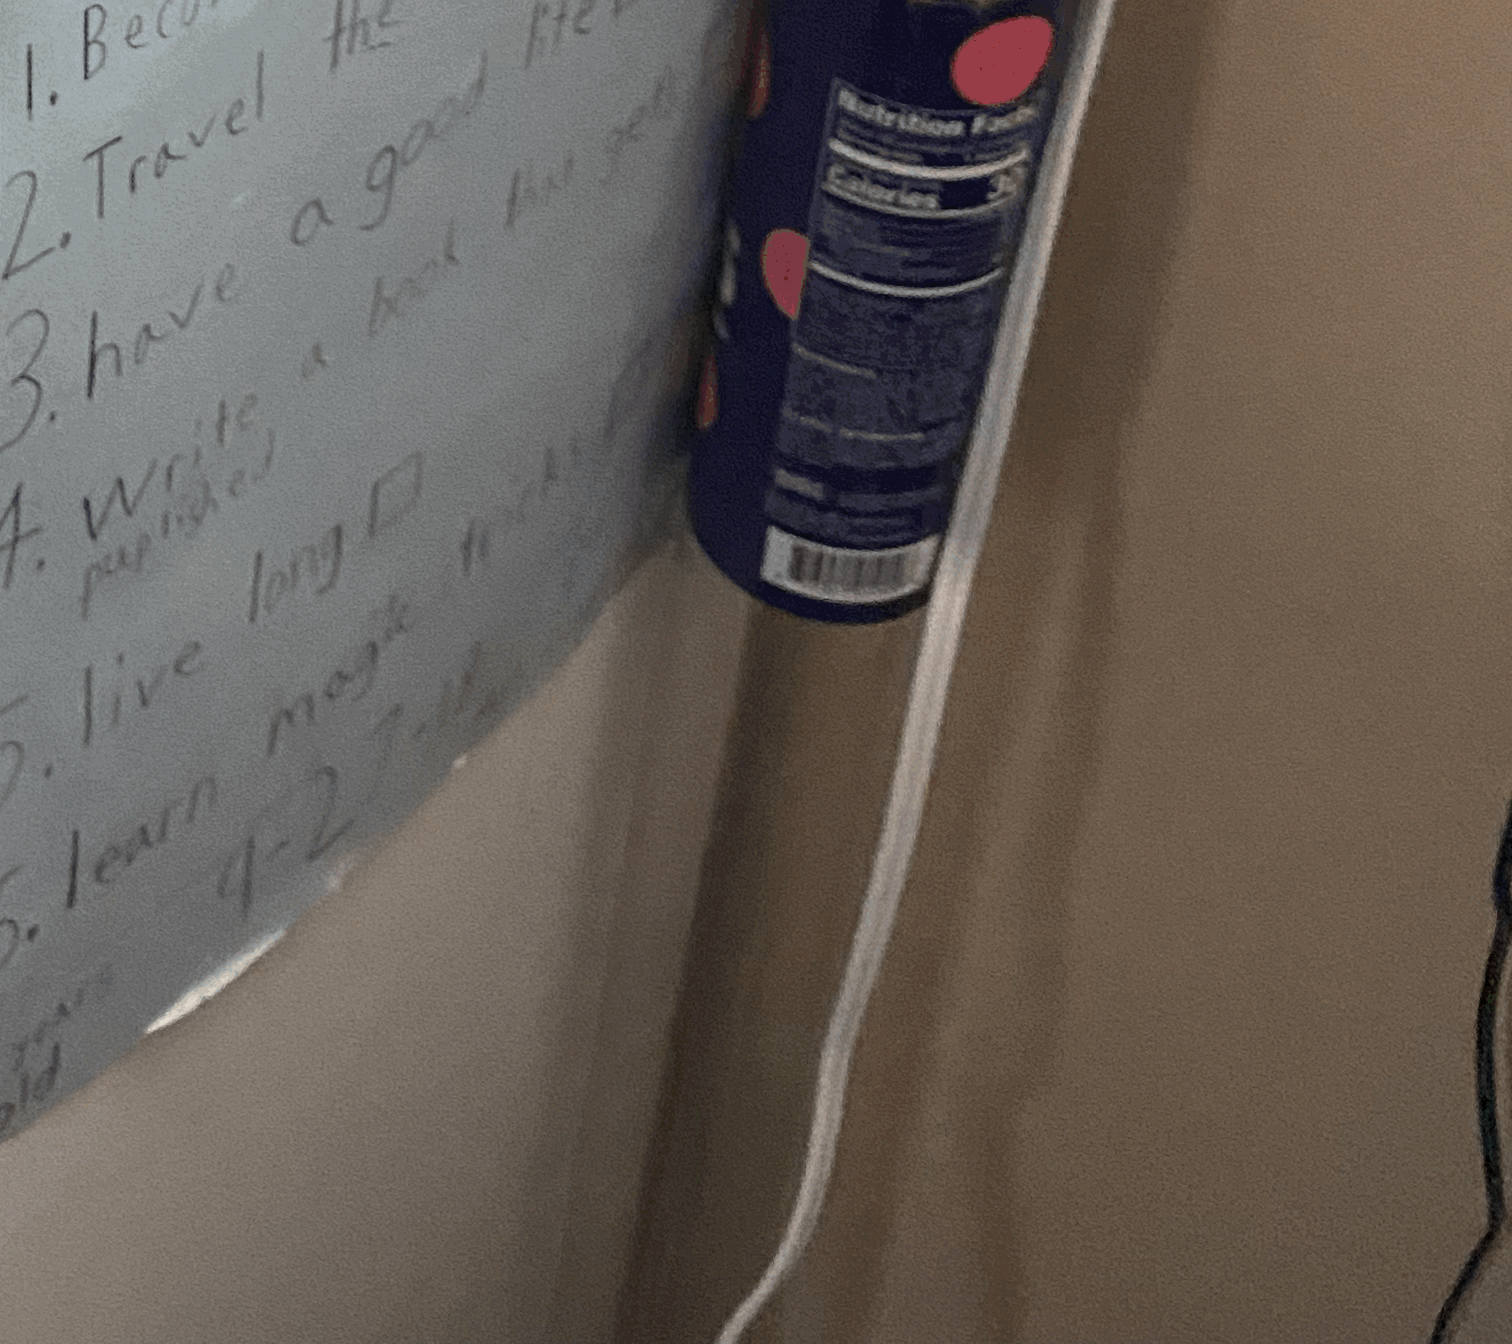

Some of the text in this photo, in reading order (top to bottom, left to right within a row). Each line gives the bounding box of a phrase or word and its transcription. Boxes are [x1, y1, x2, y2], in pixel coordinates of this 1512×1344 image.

[1, 169, 73, 281] 2.
[81, 48, 266, 221] Travel
[24, 42, 60, 121] 1.
[84, 262, 236, 402] have
[288, 194, 335, 248] a
[358, 48, 489, 233] good
[299, 340, 328, 380] a
[80, 639, 205, 749] live
[247, 520, 345, 625] long
[63, 772, 218, 912] learn
